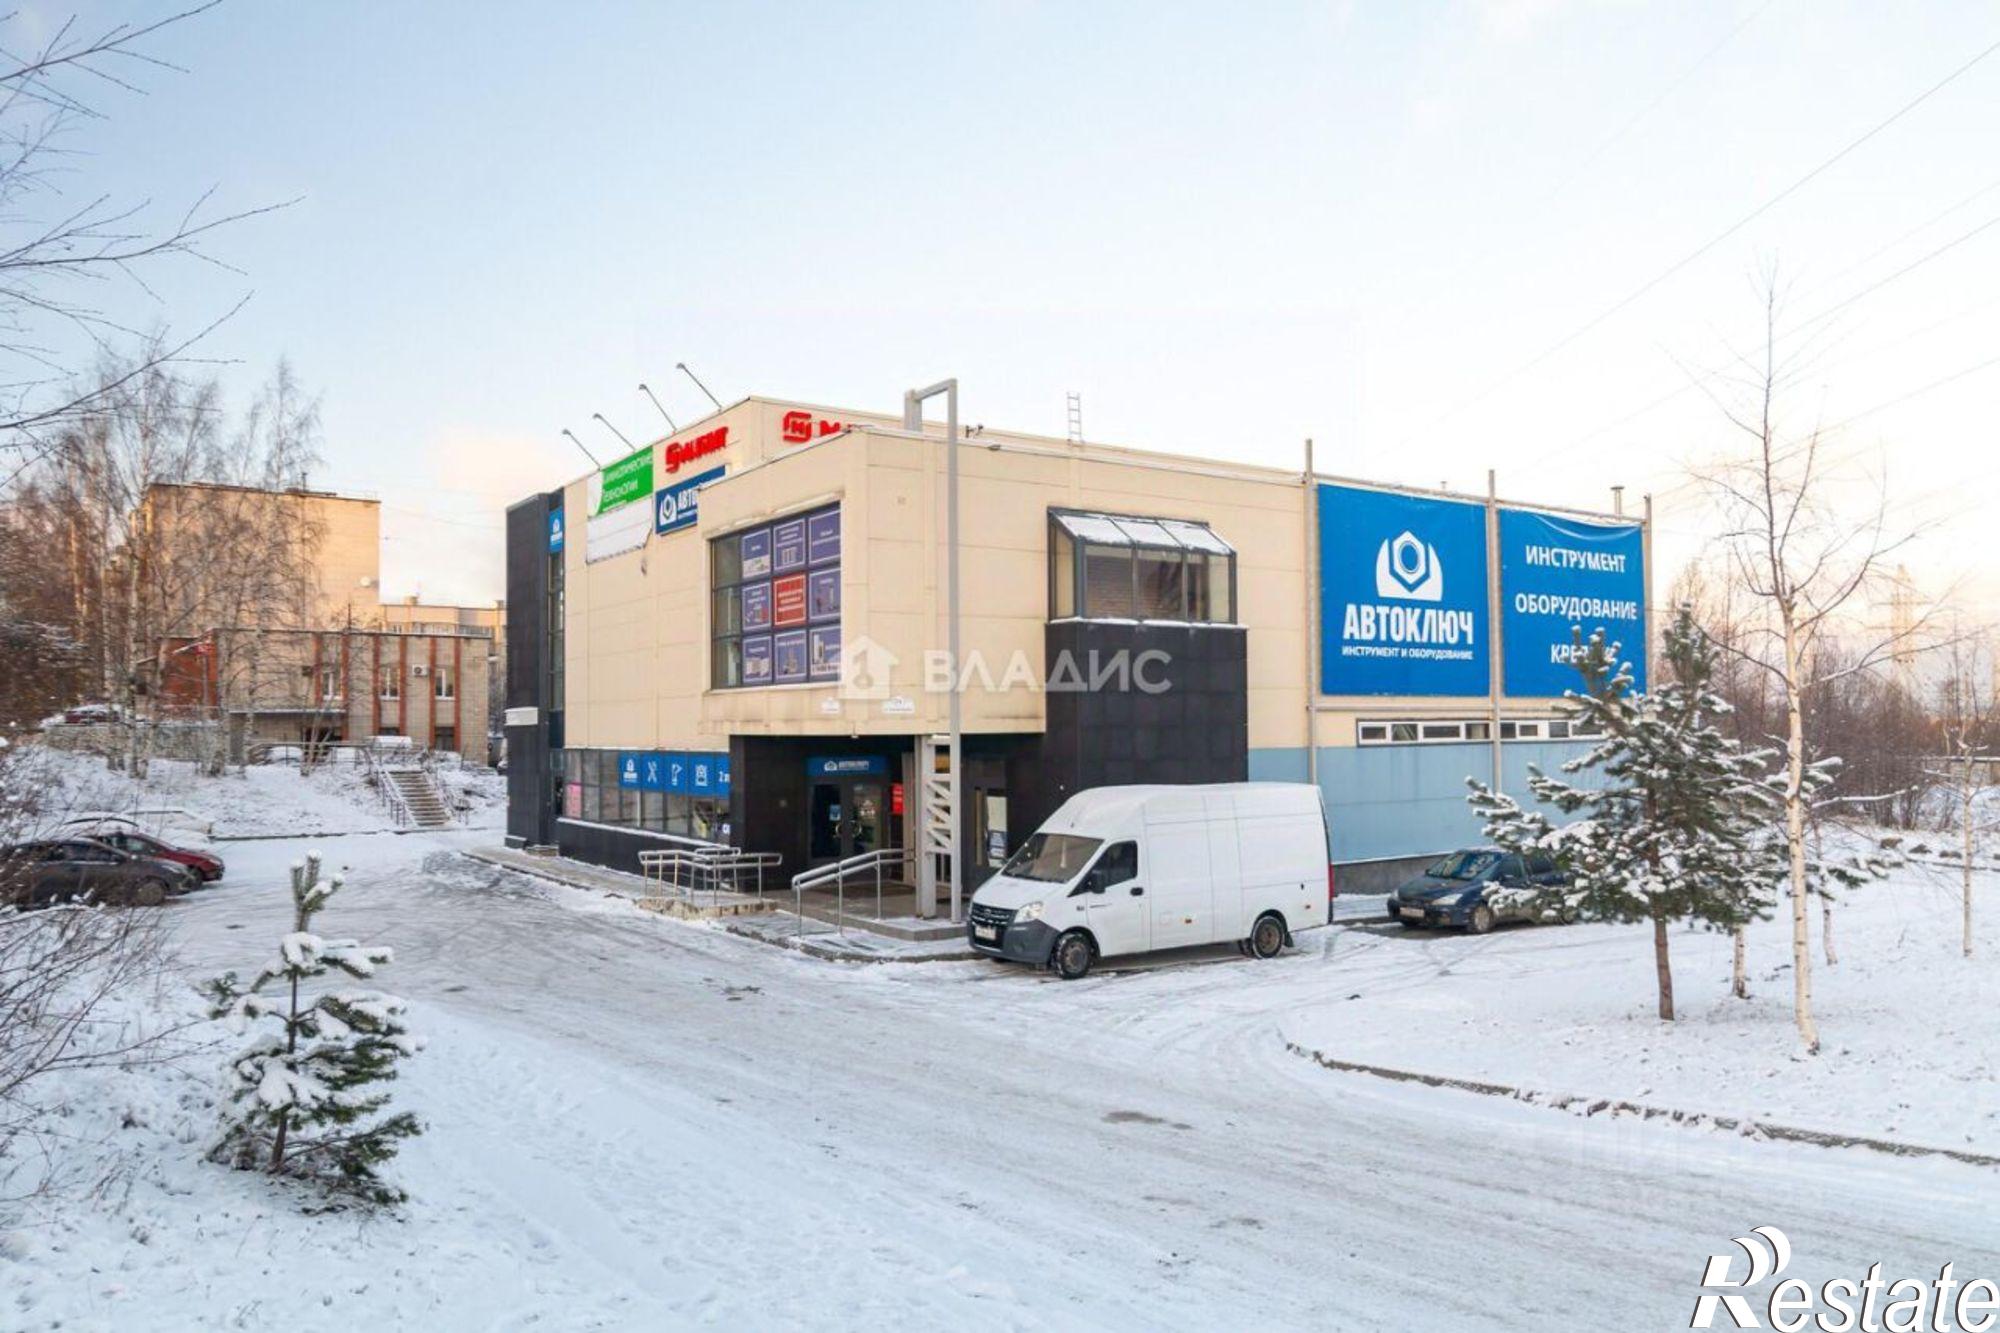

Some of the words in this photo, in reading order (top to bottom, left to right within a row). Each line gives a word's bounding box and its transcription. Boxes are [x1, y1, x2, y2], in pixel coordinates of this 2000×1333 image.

[1525, 545, 1626, 573] ИНСТРУМЕНТ
[1515, 593, 1638, 621] ОБОРУДОВАНИЕ
[1343, 603, 1474, 644] АВТОКЛЮЧ
[1342, 645, 1399, 657] ИНСТРУМЕНТ
[1401, 647, 1408, 658] И
[1409, 647, 1474, 660] ОБОРУДОВАНИЕ
